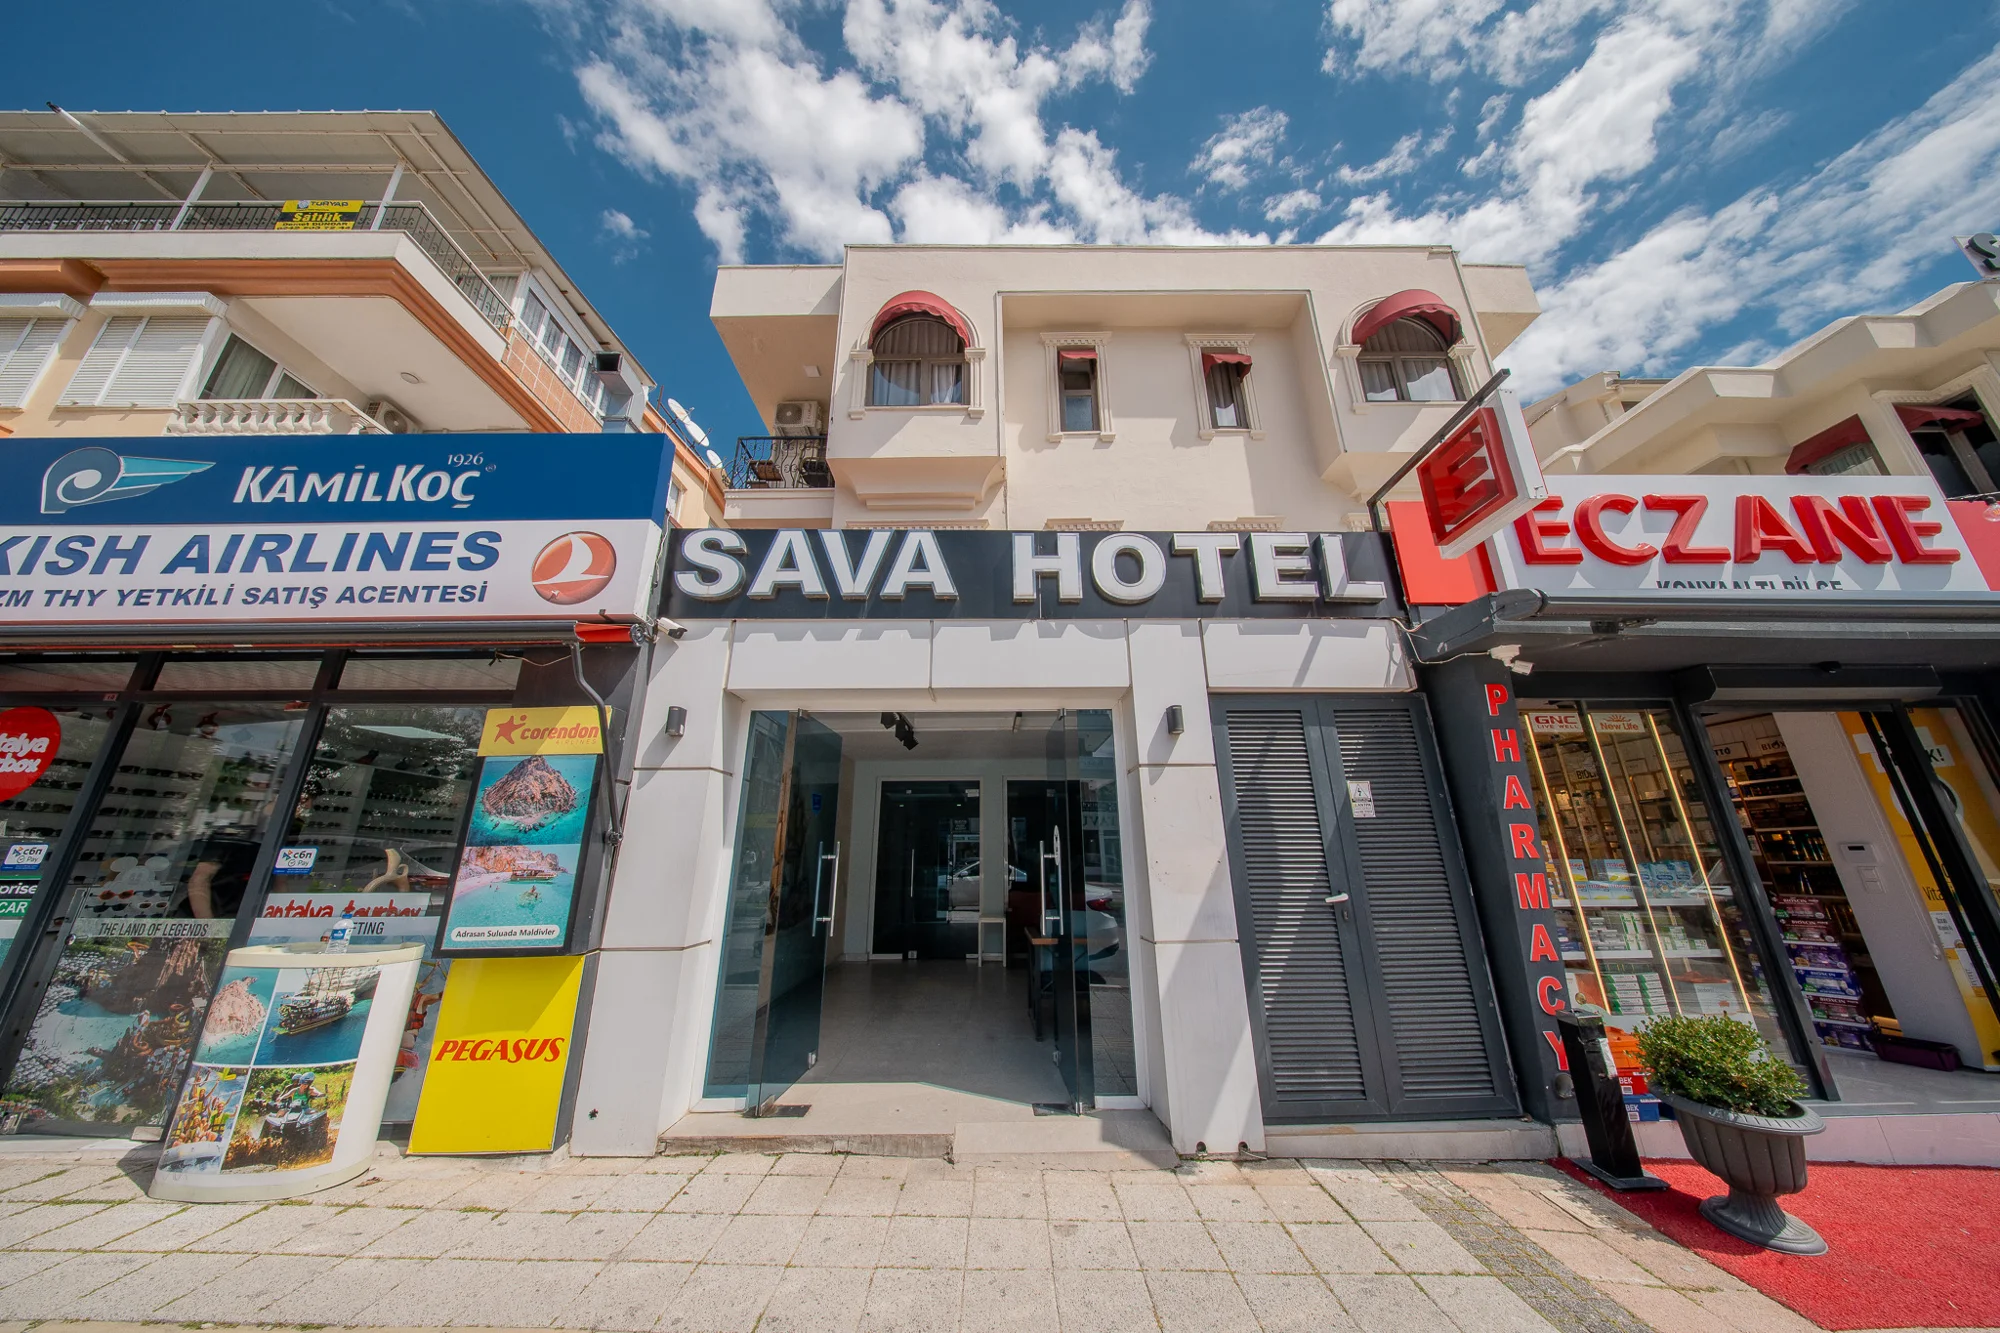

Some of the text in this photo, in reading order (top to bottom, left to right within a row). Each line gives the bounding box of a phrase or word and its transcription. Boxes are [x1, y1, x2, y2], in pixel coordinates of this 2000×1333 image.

[447, 452, 483, 467] 1926
[1514, 493, 1961, 566] ECZANE
[161, 531, 502, 574] AIRLINES
[673, 529, 1387, 603] SAVA HOTEL
[44, 589, 107, 607] THY
[116, 585, 236, 607] YETKİLİ
[241, 583, 328, 608] SATIŞ
[334, 580, 488, 604] ACENTESİ
[1535, 716, 1577, 724] GNC
[1600, 722, 1638, 730] New Life
[520, 723, 599, 740] corendon
[99, 923, 209, 936] THE LAND OF LEGENDS
[456, 928, 555, 938] Adrasan Suluada Maldivler
[434, 1036, 565, 1063] PEGASUS
